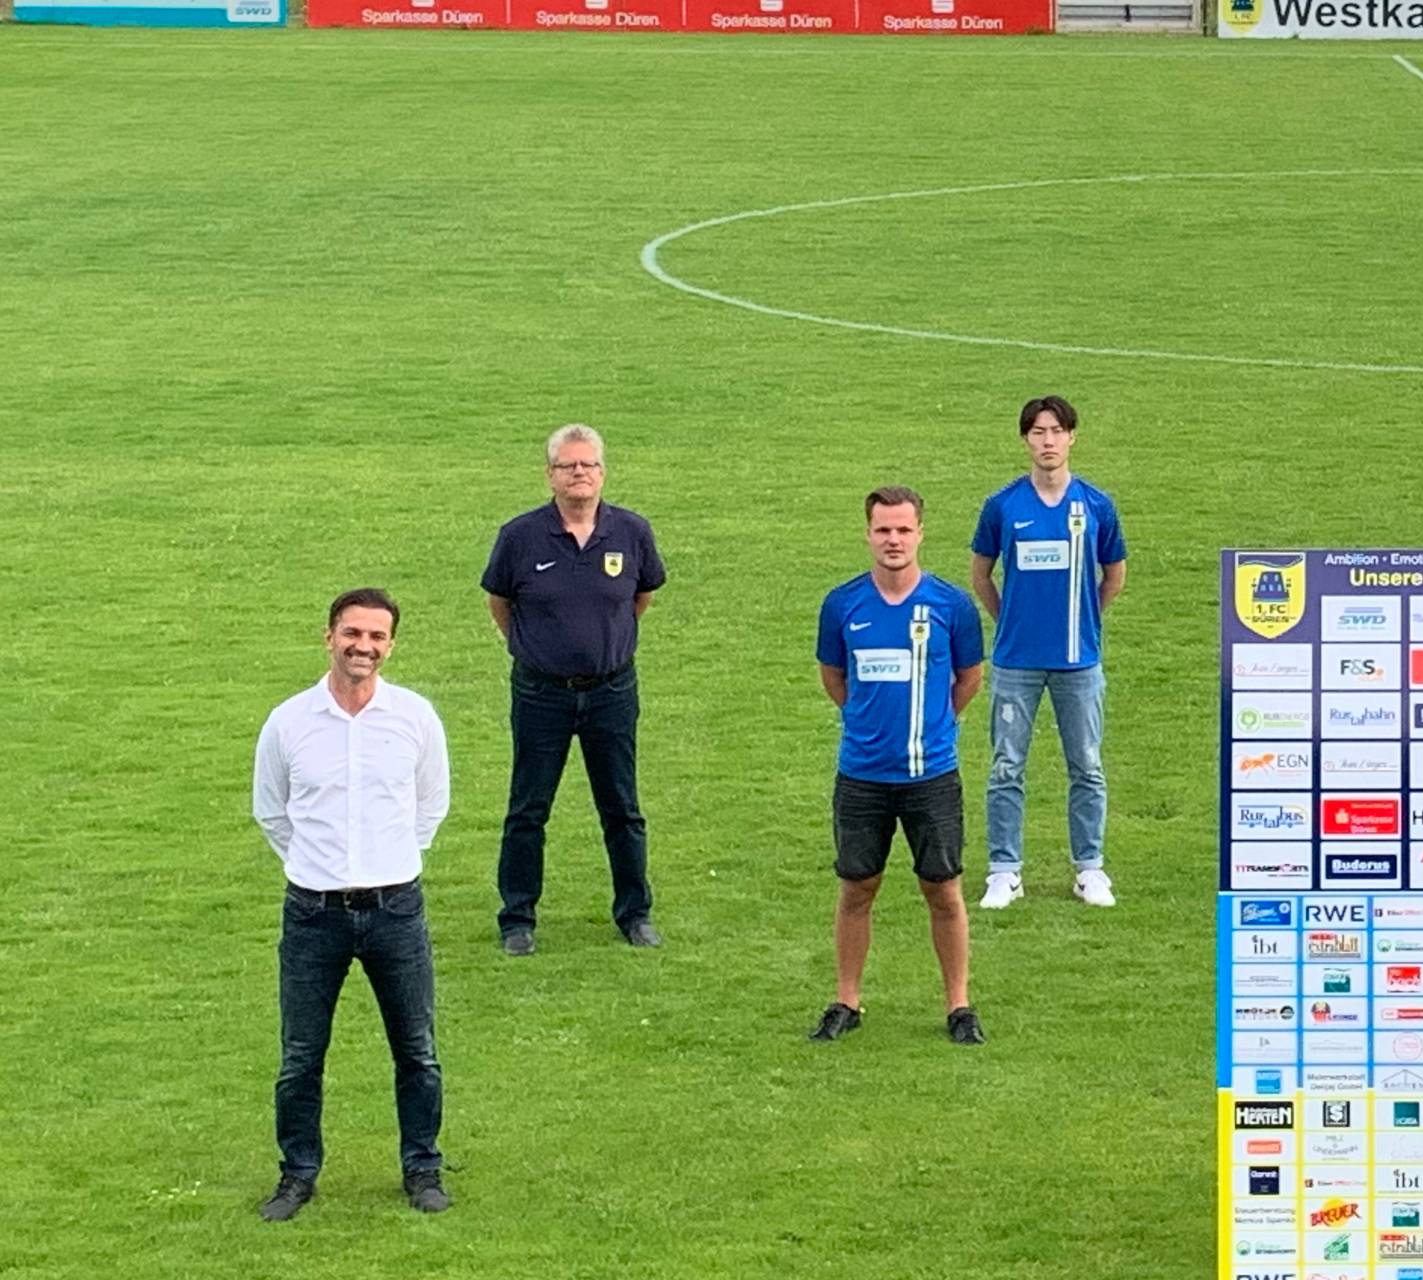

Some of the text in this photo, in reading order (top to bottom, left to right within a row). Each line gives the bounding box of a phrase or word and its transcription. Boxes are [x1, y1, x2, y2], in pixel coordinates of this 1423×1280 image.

[362, 8, 483, 24] Sparkasse Düren
[536, 11, 660, 26] Sparkasse Düren
[711, 13, 832, 29] Sparkasse Düren
[884, 15, 1003, 30] Sparkasse Düren
[1023, 553, 1061, 564] SWD
[1324, 553, 1379, 565] Ambition
[1350, 567, 1423, 587] Unsere
[1269, 604, 1286, 613] FC
[1337, 615, 1387, 625] SWD
[861, 664, 901, 674] SWD
[1276, 754, 1309, 768] EGN
[1332, 858, 1390, 872] Buderus
[1305, 905, 1365, 922] RWE
[1236, 1107, 1292, 1125] HERTEN
[1310, 1203, 1362, 1227] BREUER
